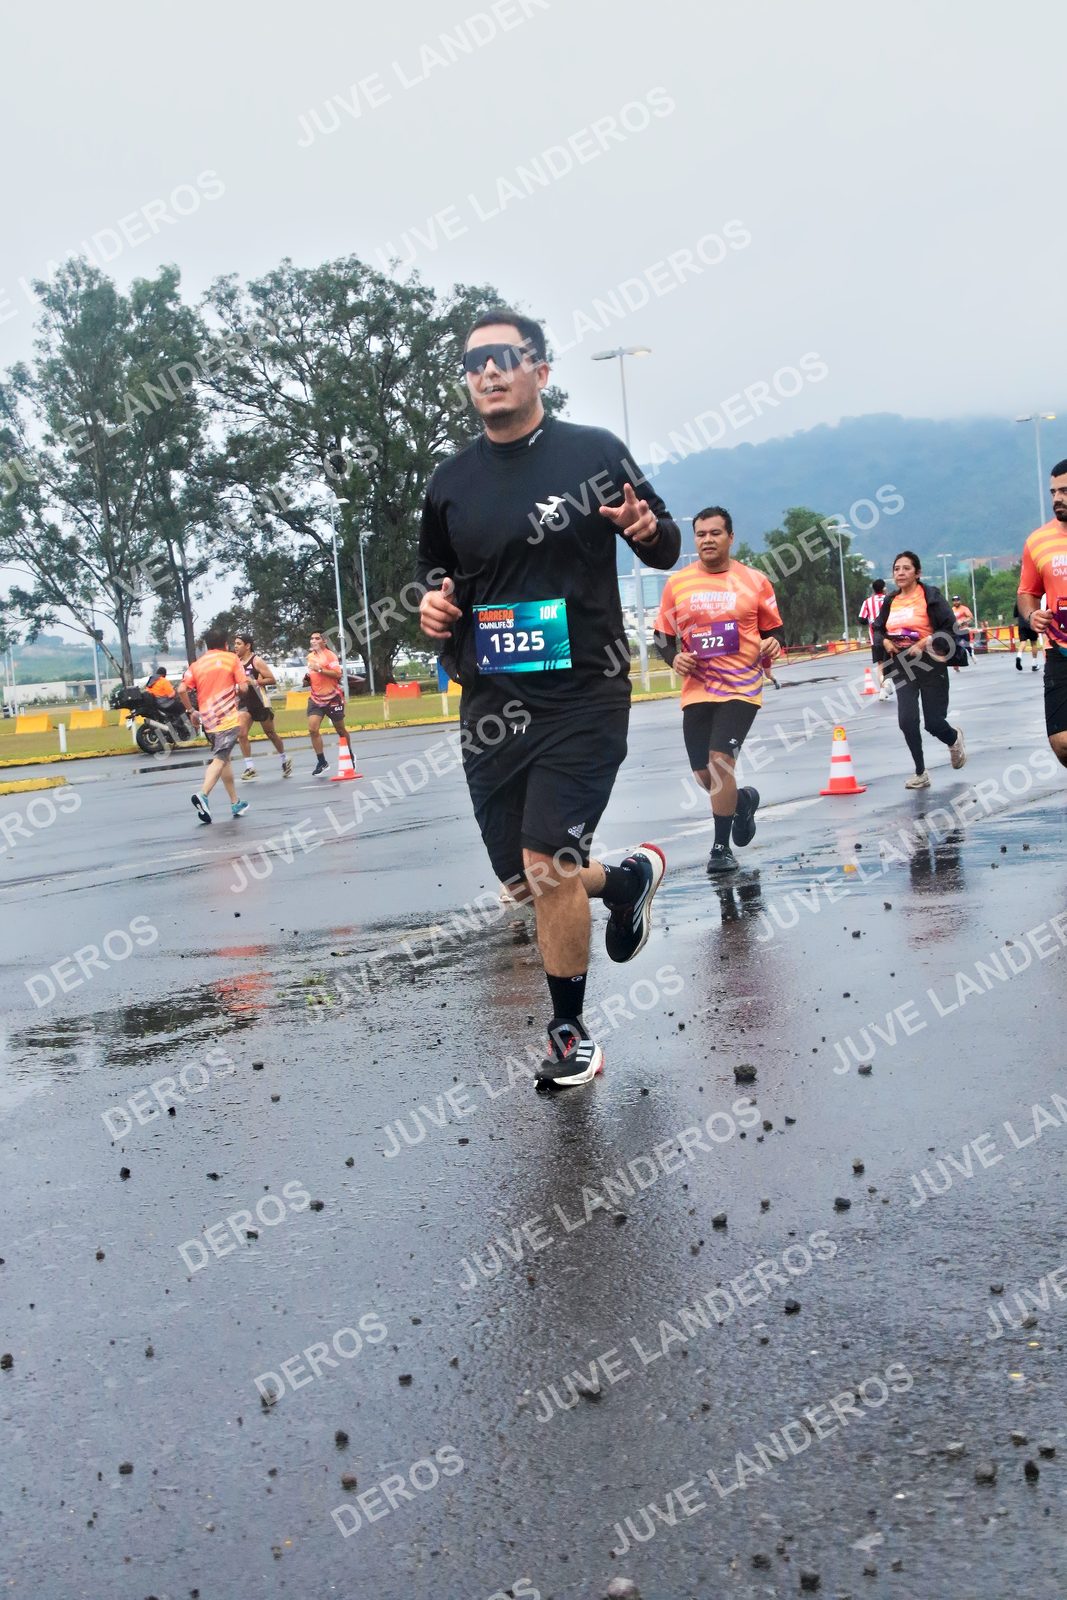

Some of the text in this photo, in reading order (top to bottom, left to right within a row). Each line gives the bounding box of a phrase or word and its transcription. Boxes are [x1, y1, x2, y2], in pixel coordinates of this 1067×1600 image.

[478, 610, 514, 622] CARRERA
[540, 606, 558, 620] 10K
[490, 631, 545, 653] 1325
[702, 636, 724, 648] 272
